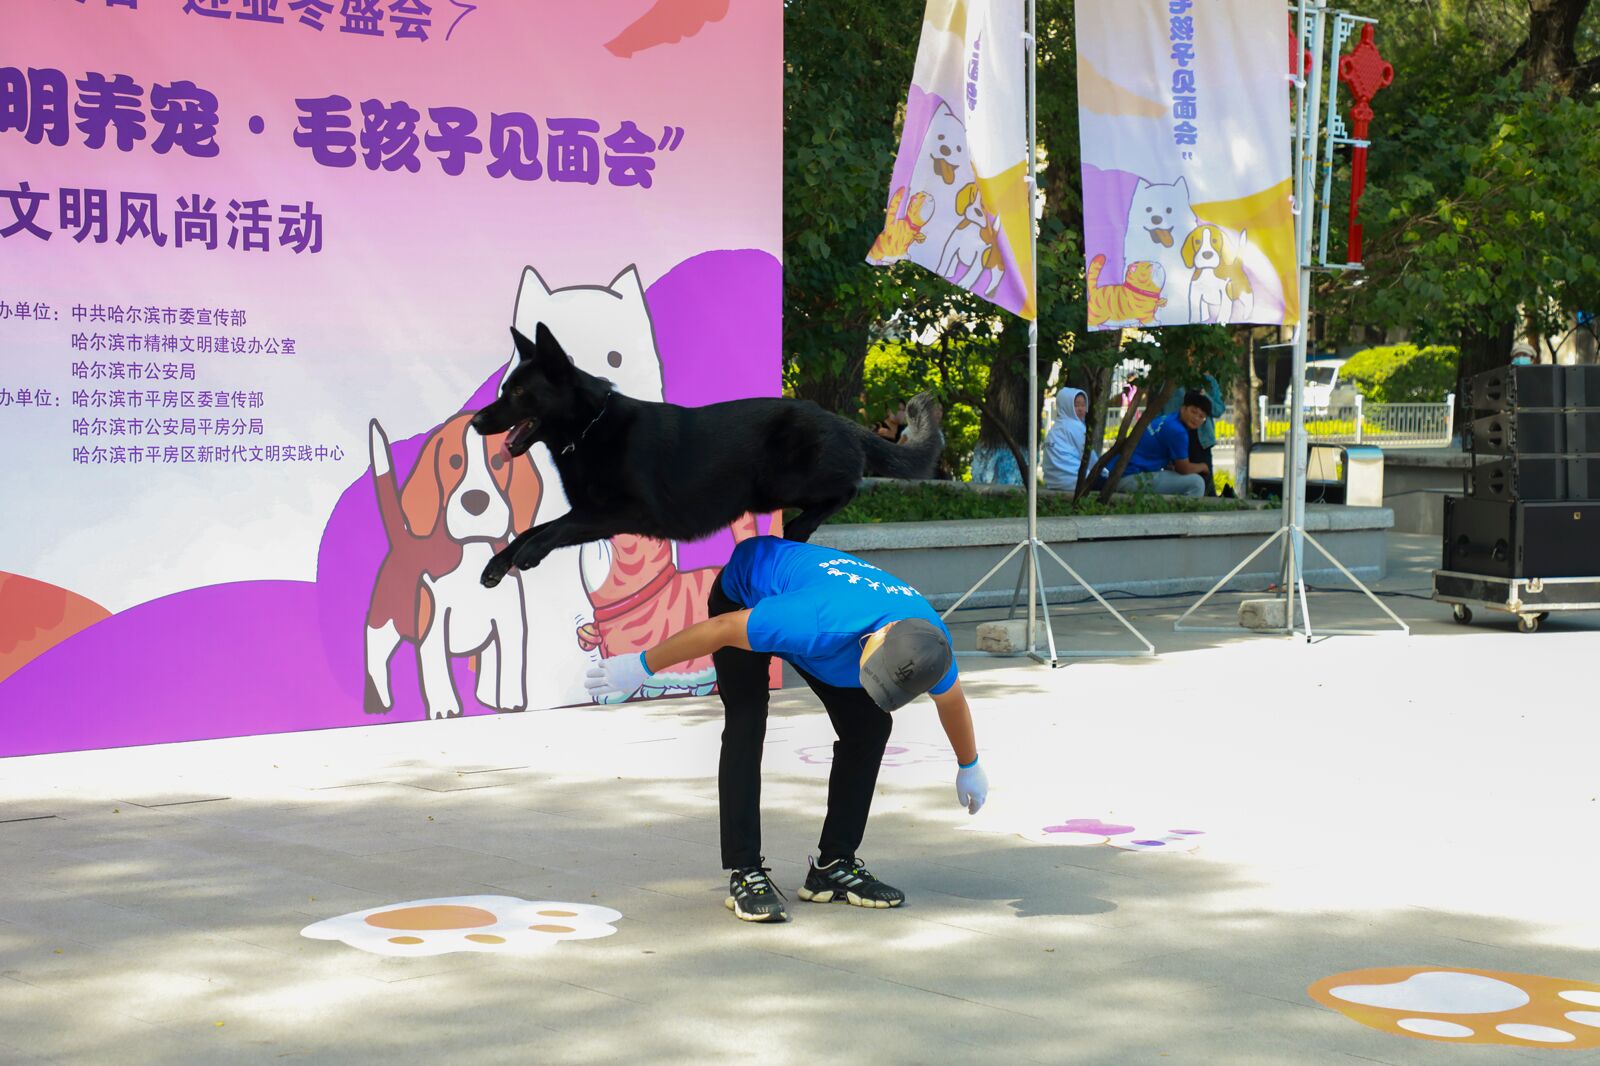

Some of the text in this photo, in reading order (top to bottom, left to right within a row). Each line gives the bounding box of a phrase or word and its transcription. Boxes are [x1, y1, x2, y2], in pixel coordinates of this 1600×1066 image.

[0, 181, 323, 254] 文明风尚活动
[71, 303, 247, 328] 中共哈尔滨市委宣传部
[71, 331, 296, 356] 哈尔滨市精神文明建设办公室
[71, 360, 196, 381] 哈尔滨市公安局
[71, 388, 265, 409] 哈尔滨市平房区委宣传部
[72, 417, 264, 437] 哈尔滨市公安局平房分局
[72, 443, 345, 465] 哈尔滨市平房区新时代文明实践中心
